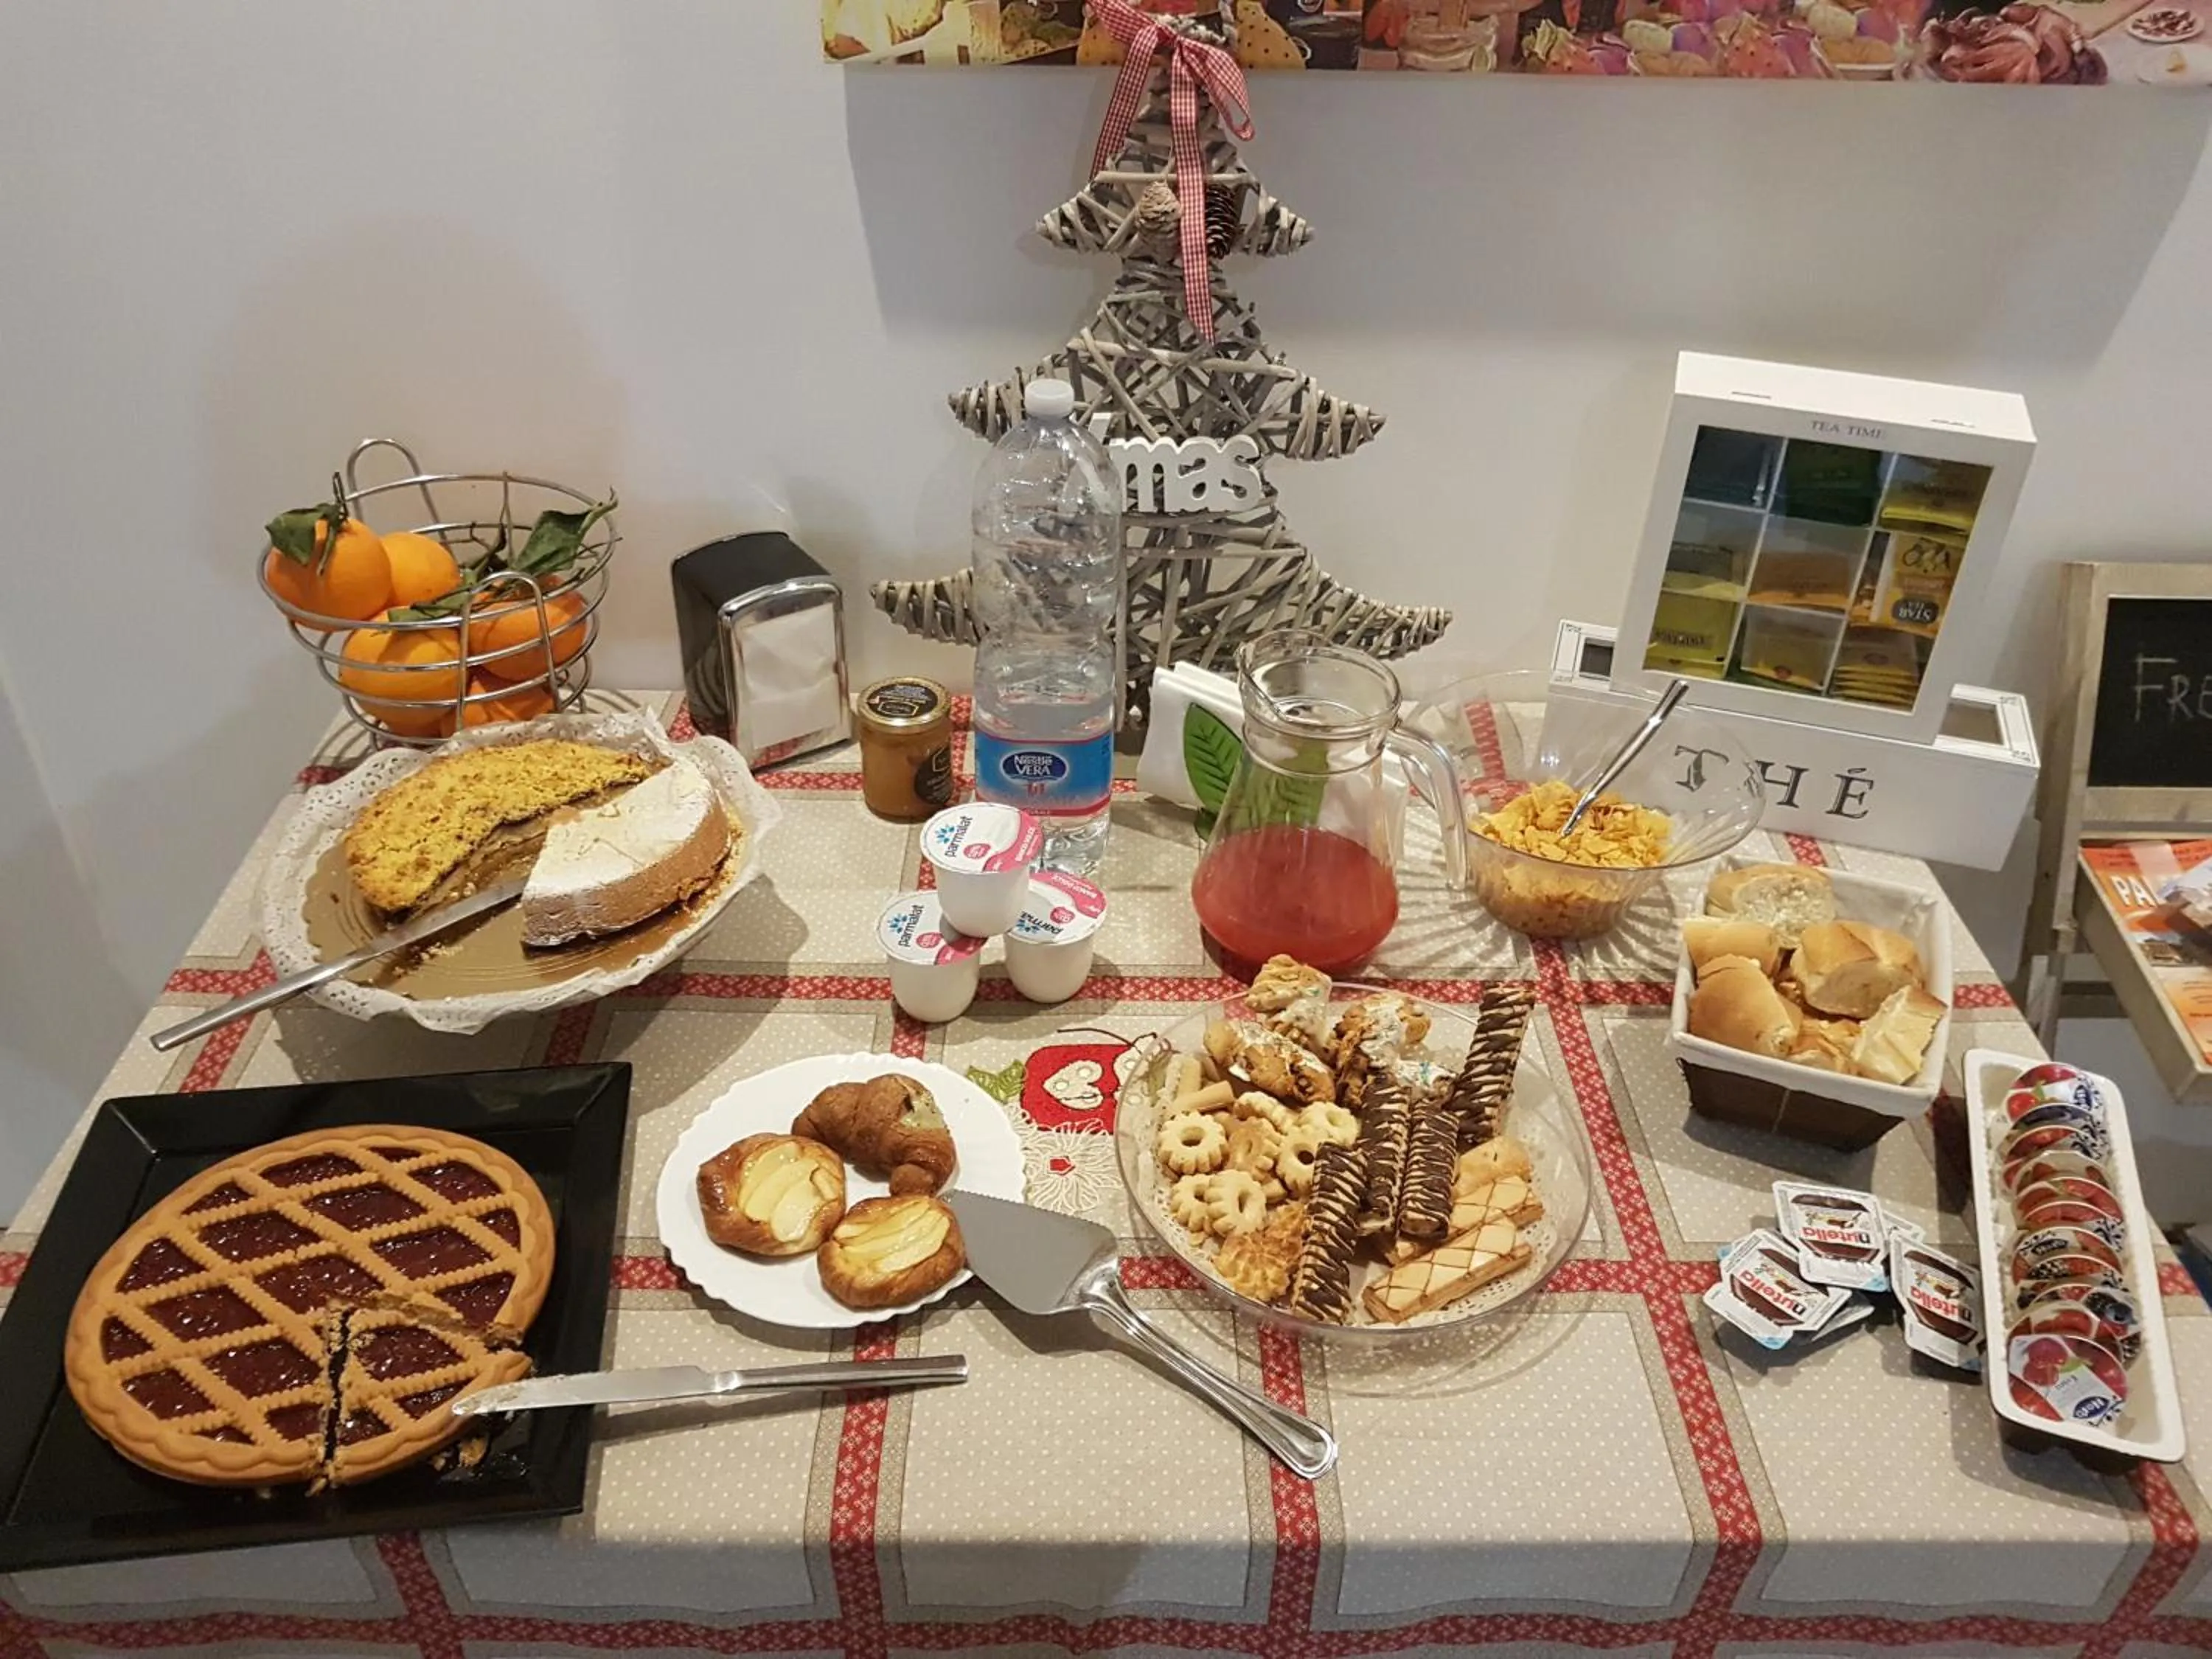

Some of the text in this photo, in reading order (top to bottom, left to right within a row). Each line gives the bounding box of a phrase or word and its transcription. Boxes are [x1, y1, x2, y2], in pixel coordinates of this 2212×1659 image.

[1812, 420, 1885, 439] TEA TIME
[1015, 765, 1050, 776] VERA
[1674, 744, 1874, 819] THÉ
[945, 815, 973, 857] parmalat
[898, 905, 925, 947] parmalat
[1020, 911, 1062, 934] parma
[1802, 1227, 1871, 1244] nutella
[1739, 1270, 1806, 1315] nutella
[1910, 1287, 1972, 1322] nutella
